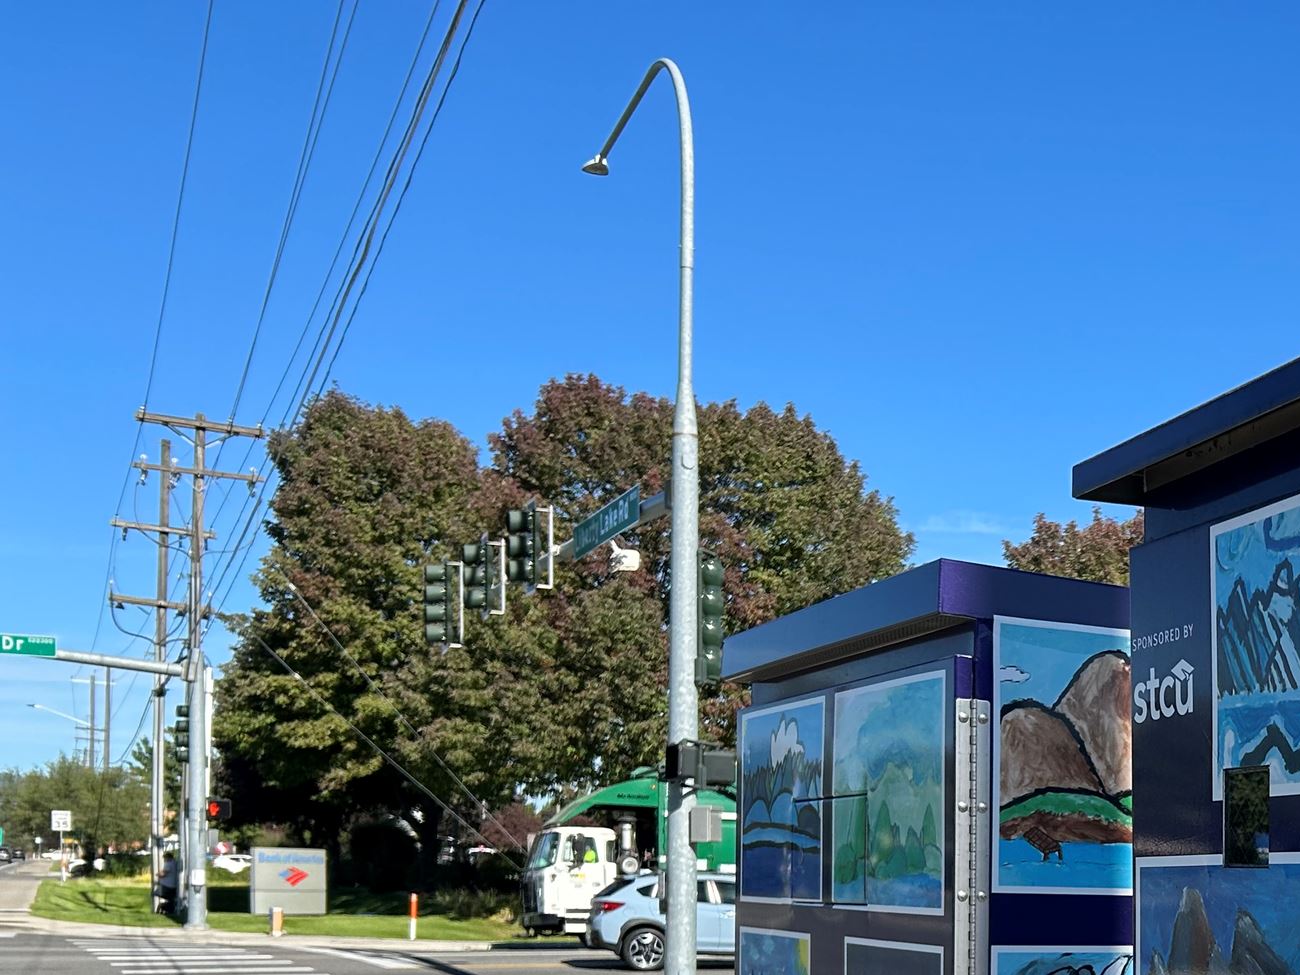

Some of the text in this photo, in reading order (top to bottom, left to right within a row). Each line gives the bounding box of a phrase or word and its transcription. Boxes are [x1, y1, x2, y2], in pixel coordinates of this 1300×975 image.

[600, 507, 617, 536] Lake
[618, 495, 629, 524] Rd
[1, 635, 24, 651] Dr
[1132, 623, 1194, 652] SPONSORED BY
[1133, 660, 1194, 724] stcu
